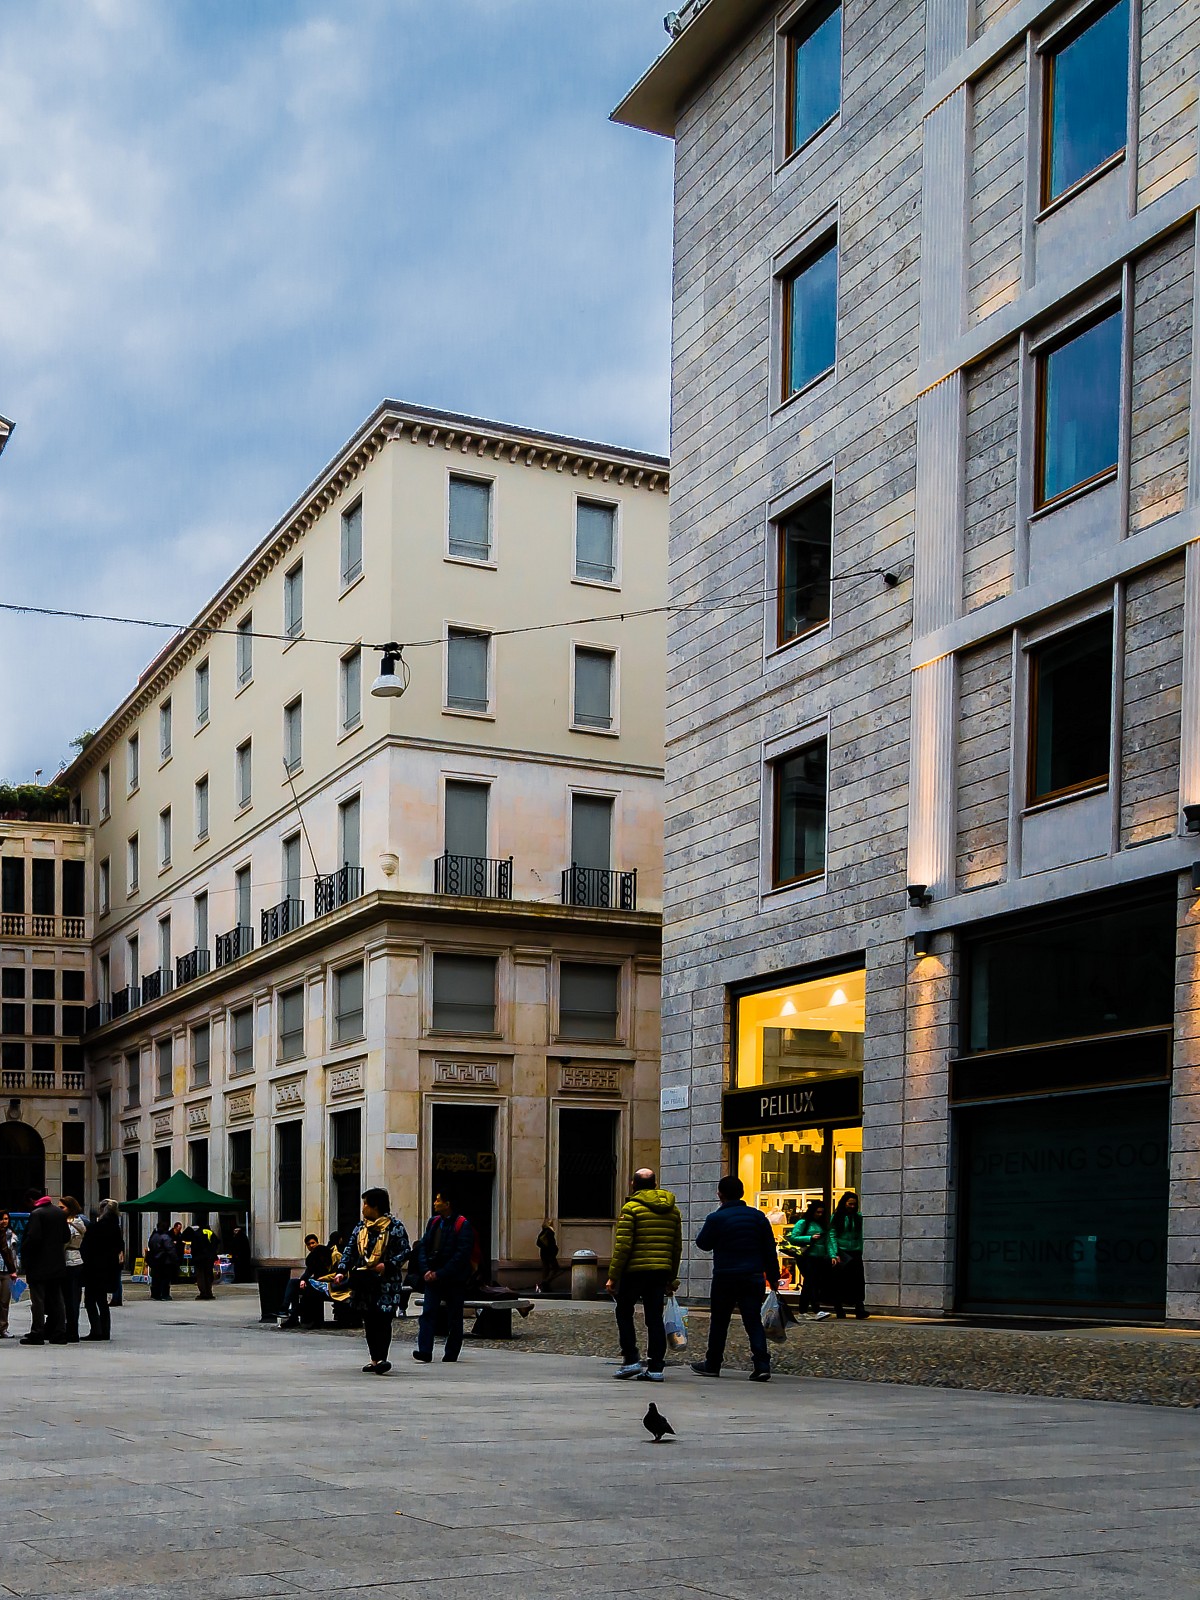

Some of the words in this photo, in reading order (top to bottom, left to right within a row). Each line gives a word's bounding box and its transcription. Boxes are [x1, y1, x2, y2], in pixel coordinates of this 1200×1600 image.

[761, 1091, 814, 1117] PELLUX
[971, 1146, 1087, 1177] OPENING
[1096, 1141, 1169, 1169] SOO
[969, 1239, 1085, 1264] OPENING
[1095, 1239, 1167, 1264] SOO
